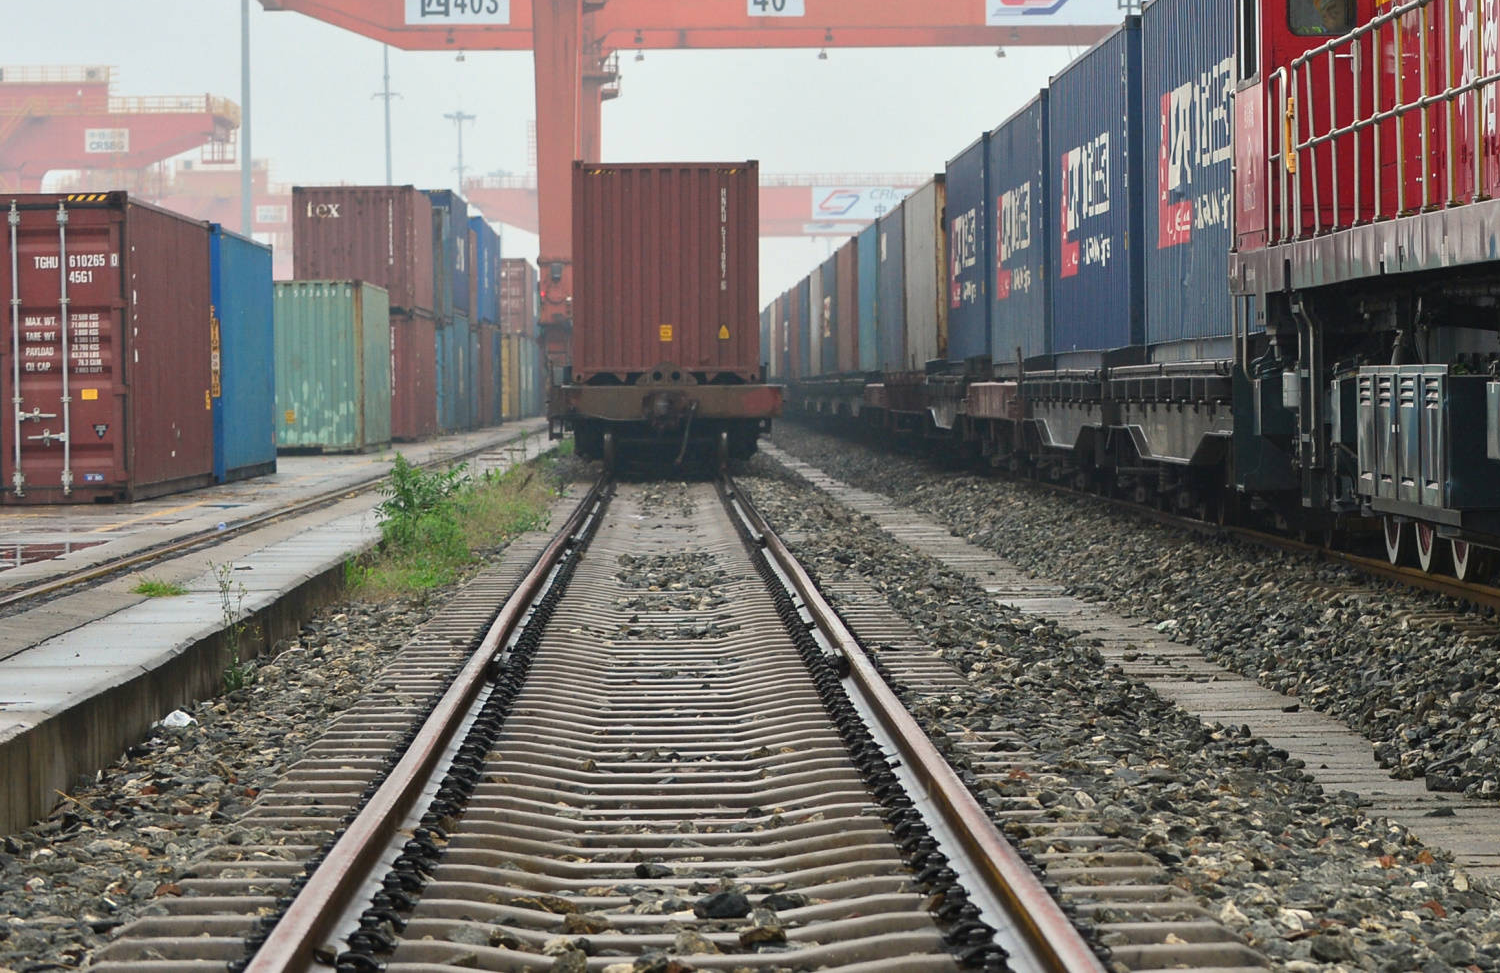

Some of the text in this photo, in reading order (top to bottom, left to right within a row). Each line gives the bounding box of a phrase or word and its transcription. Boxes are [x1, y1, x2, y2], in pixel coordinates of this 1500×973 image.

[307, 201, 340, 218] tex
[34, 256, 59, 269] TGHU
[69, 253, 105, 268] 610265
[69, 271, 93, 283] 45G1
